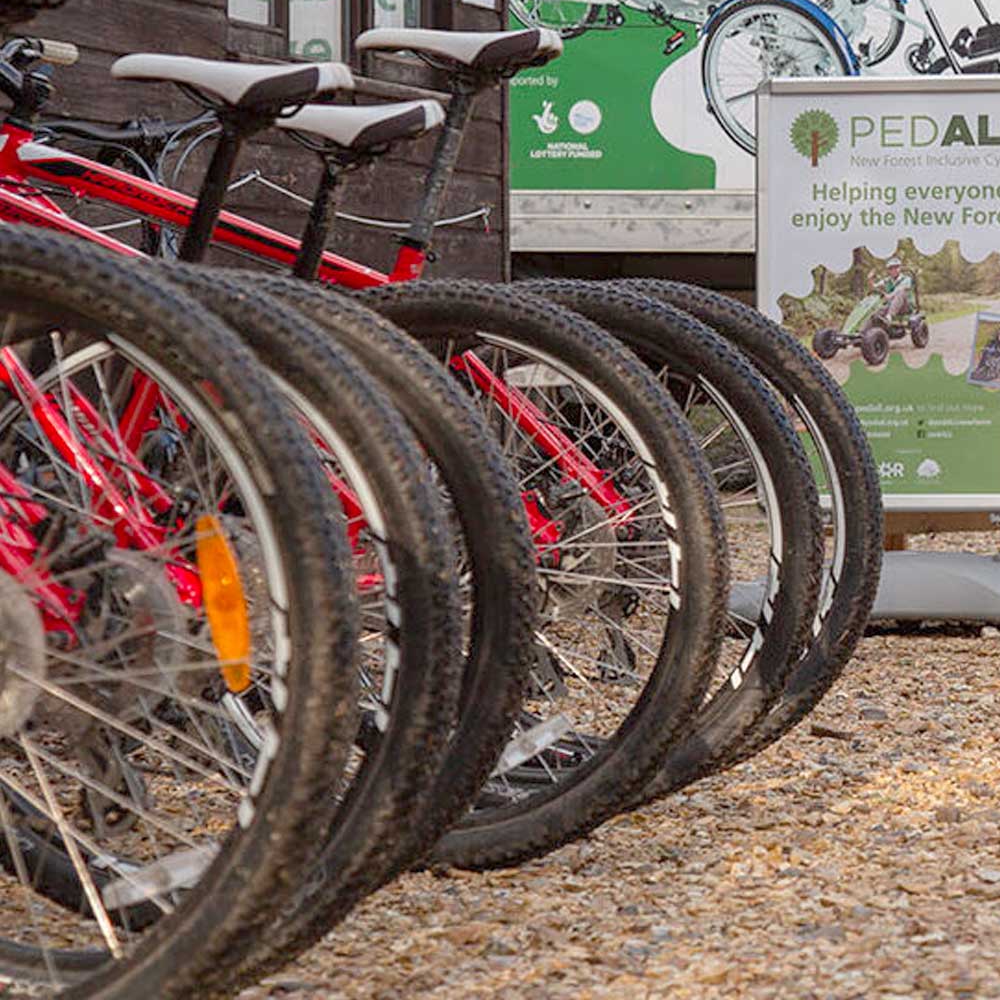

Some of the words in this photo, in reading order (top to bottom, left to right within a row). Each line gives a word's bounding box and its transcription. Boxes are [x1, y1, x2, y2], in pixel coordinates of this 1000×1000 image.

[850, 155, 881, 168] New
[883, 154, 922, 167] Forest
[926, 153, 980, 167] Inclusive
[812, 182, 897, 206] Helping
[791, 207, 853, 232] enjoy
[859, 207, 896, 226] the
[903, 207, 954, 226] New
